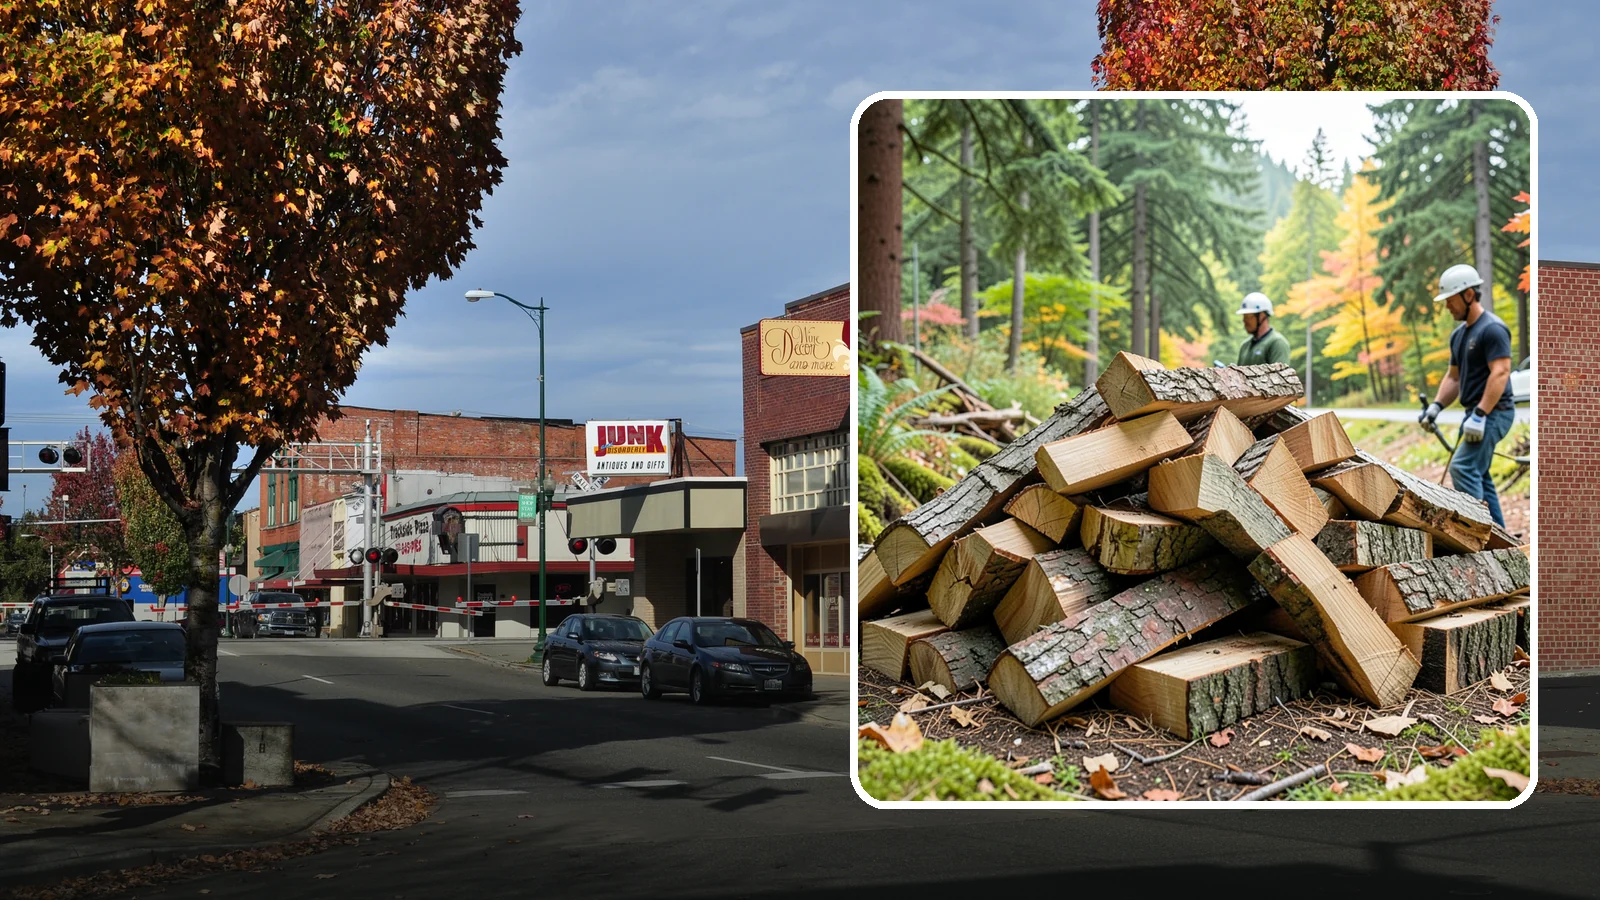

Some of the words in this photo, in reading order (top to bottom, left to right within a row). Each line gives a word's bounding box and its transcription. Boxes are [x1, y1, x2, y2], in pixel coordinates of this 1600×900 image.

[596, 425, 665, 457] JUNK
[607, 446, 646, 454] DISORDERLY
[597, 461, 628, 470] ANTIQUES
[631, 461, 644, 470] AND
[646, 461, 665, 470] GIFTS
[390, 521, 413, 540] Trackside
[414, 519, 429, 535] Pizza
